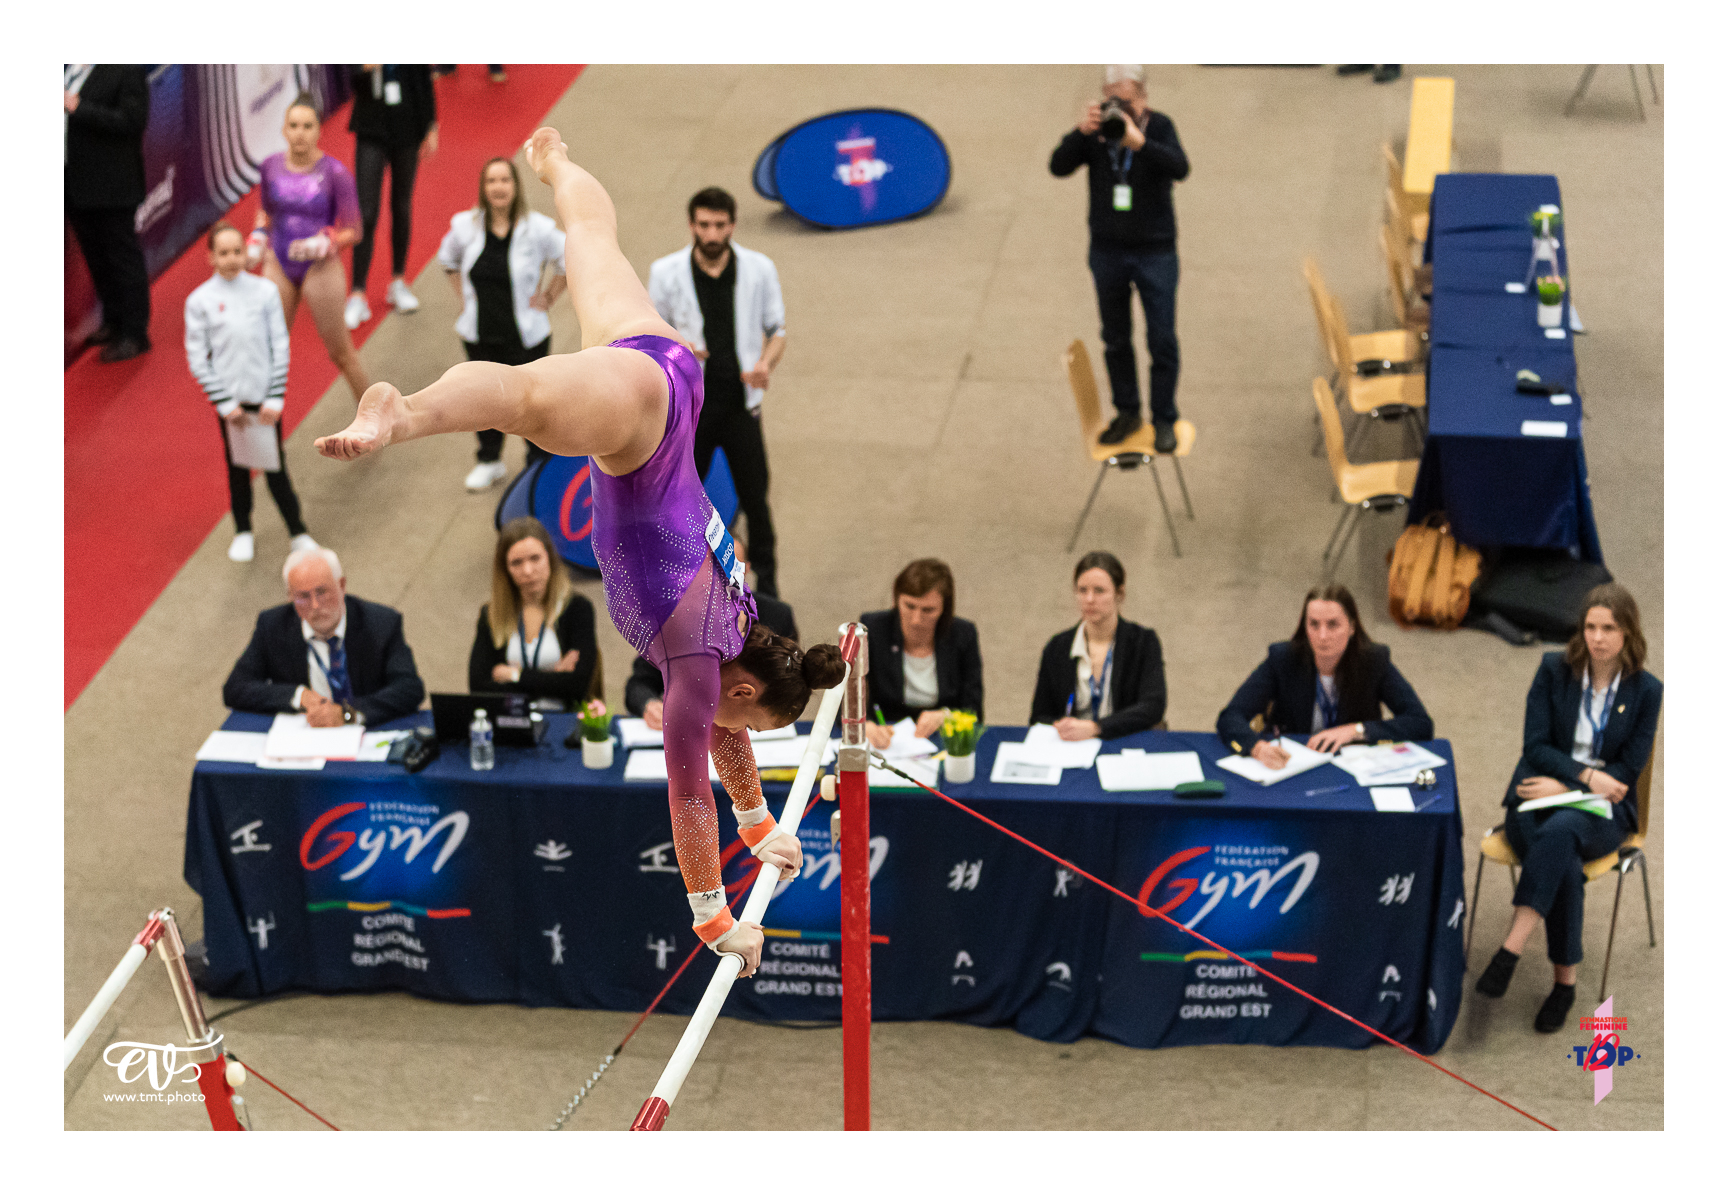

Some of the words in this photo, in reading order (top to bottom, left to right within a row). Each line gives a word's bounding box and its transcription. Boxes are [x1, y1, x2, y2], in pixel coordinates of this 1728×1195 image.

[769, 941, 831, 959] COMITÉ
[759, 960, 842, 978] RÉGIONAL
[754, 980, 812, 996] GRAND
[1184, 983, 1268, 999] RÉGIONAL
[1179, 1004, 1238, 1019] GRAND
[1240, 1003, 1272, 1018] EST
